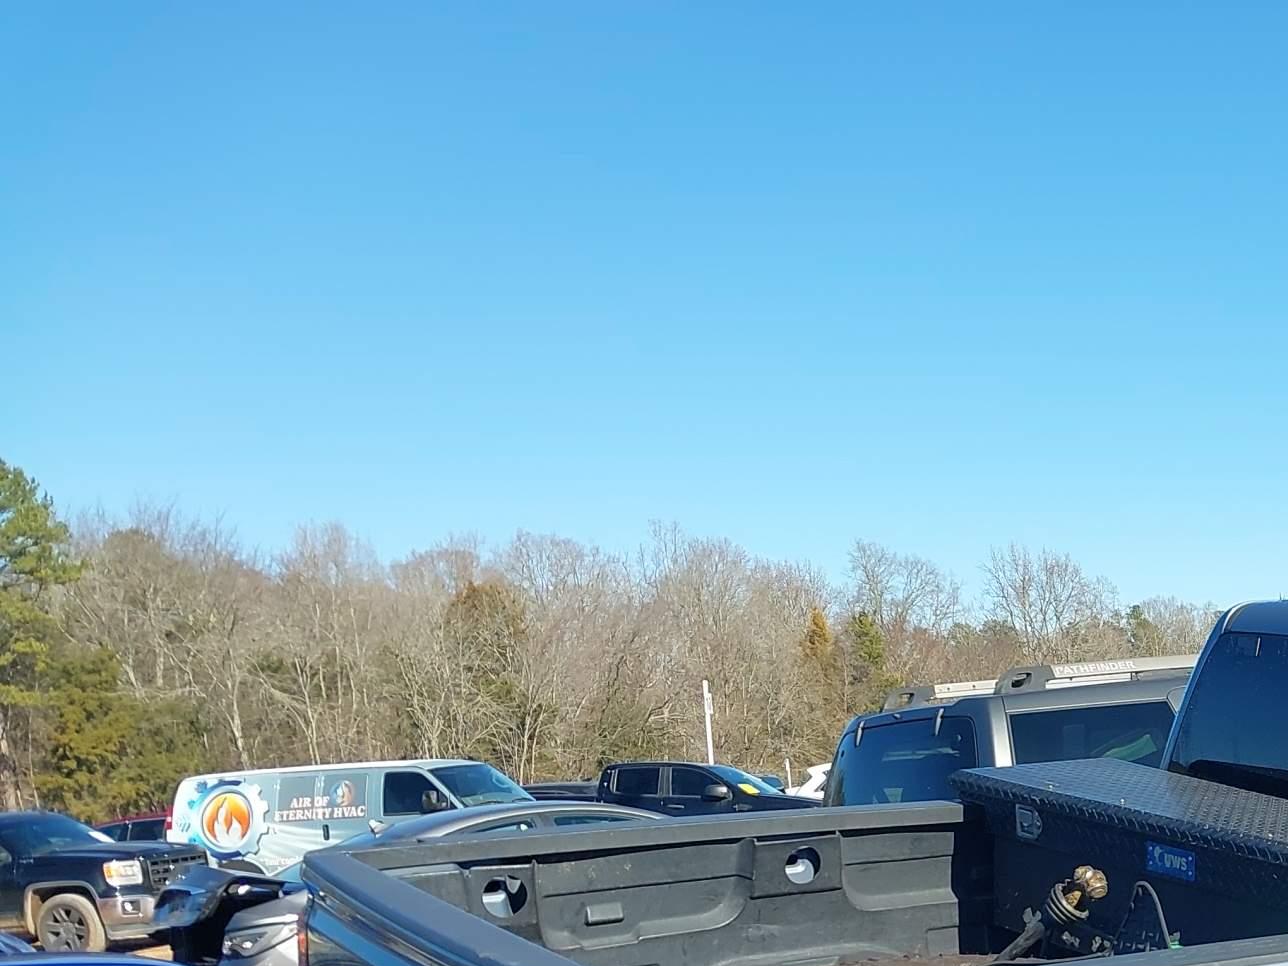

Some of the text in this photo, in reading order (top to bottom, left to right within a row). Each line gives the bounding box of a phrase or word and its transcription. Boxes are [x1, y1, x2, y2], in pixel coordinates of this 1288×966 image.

[1055, 661, 1137, 675] PATHFINDER
[290, 796, 330, 808] AIR OF
[274, 805, 366, 821] ETERNITY HVAC
[1164, 853, 1187, 871] UWS
